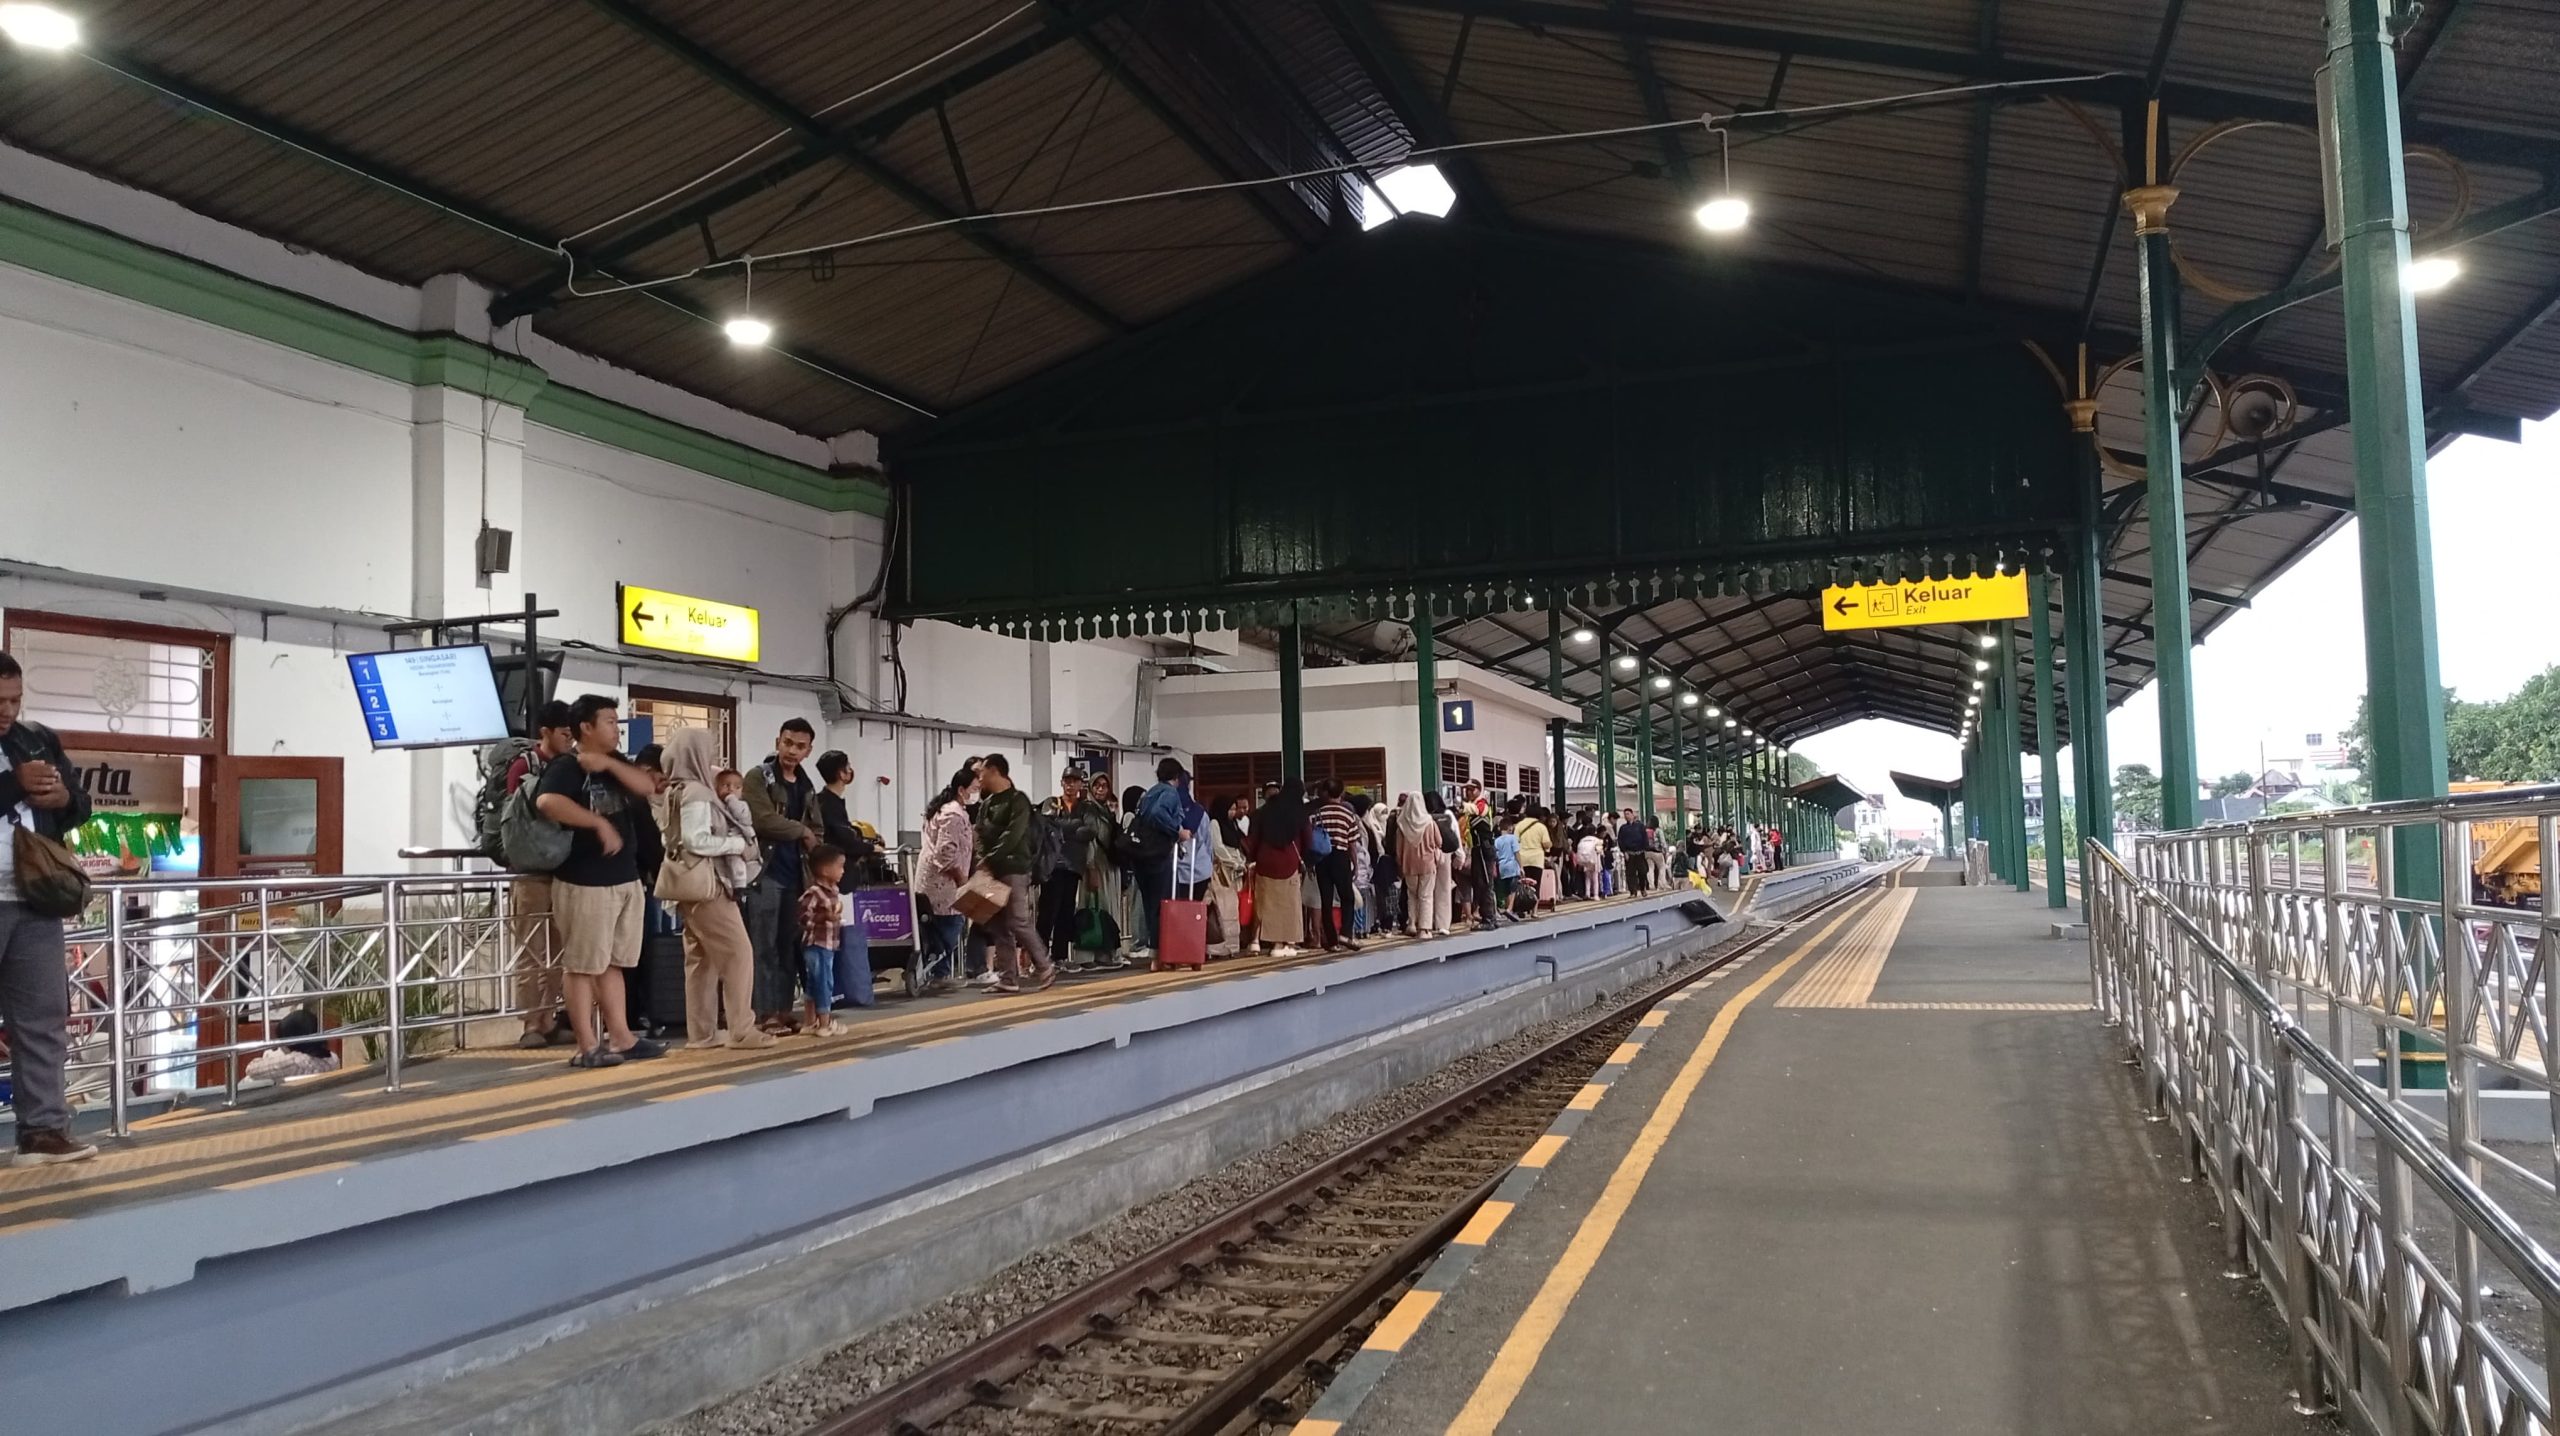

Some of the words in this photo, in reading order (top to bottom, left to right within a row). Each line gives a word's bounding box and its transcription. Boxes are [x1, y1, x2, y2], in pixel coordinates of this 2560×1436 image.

[1905, 586, 1972, 604] Keluar
[688, 607, 727, 628] Keluar
[1906, 606, 1927, 616] Exit
[363, 668, 370, 680] 1
[370, 696, 379, 708] 2
[1452, 706, 1463, 725] 1
[378, 724, 387, 735] 3
[862, 909, 900, 923] Access
